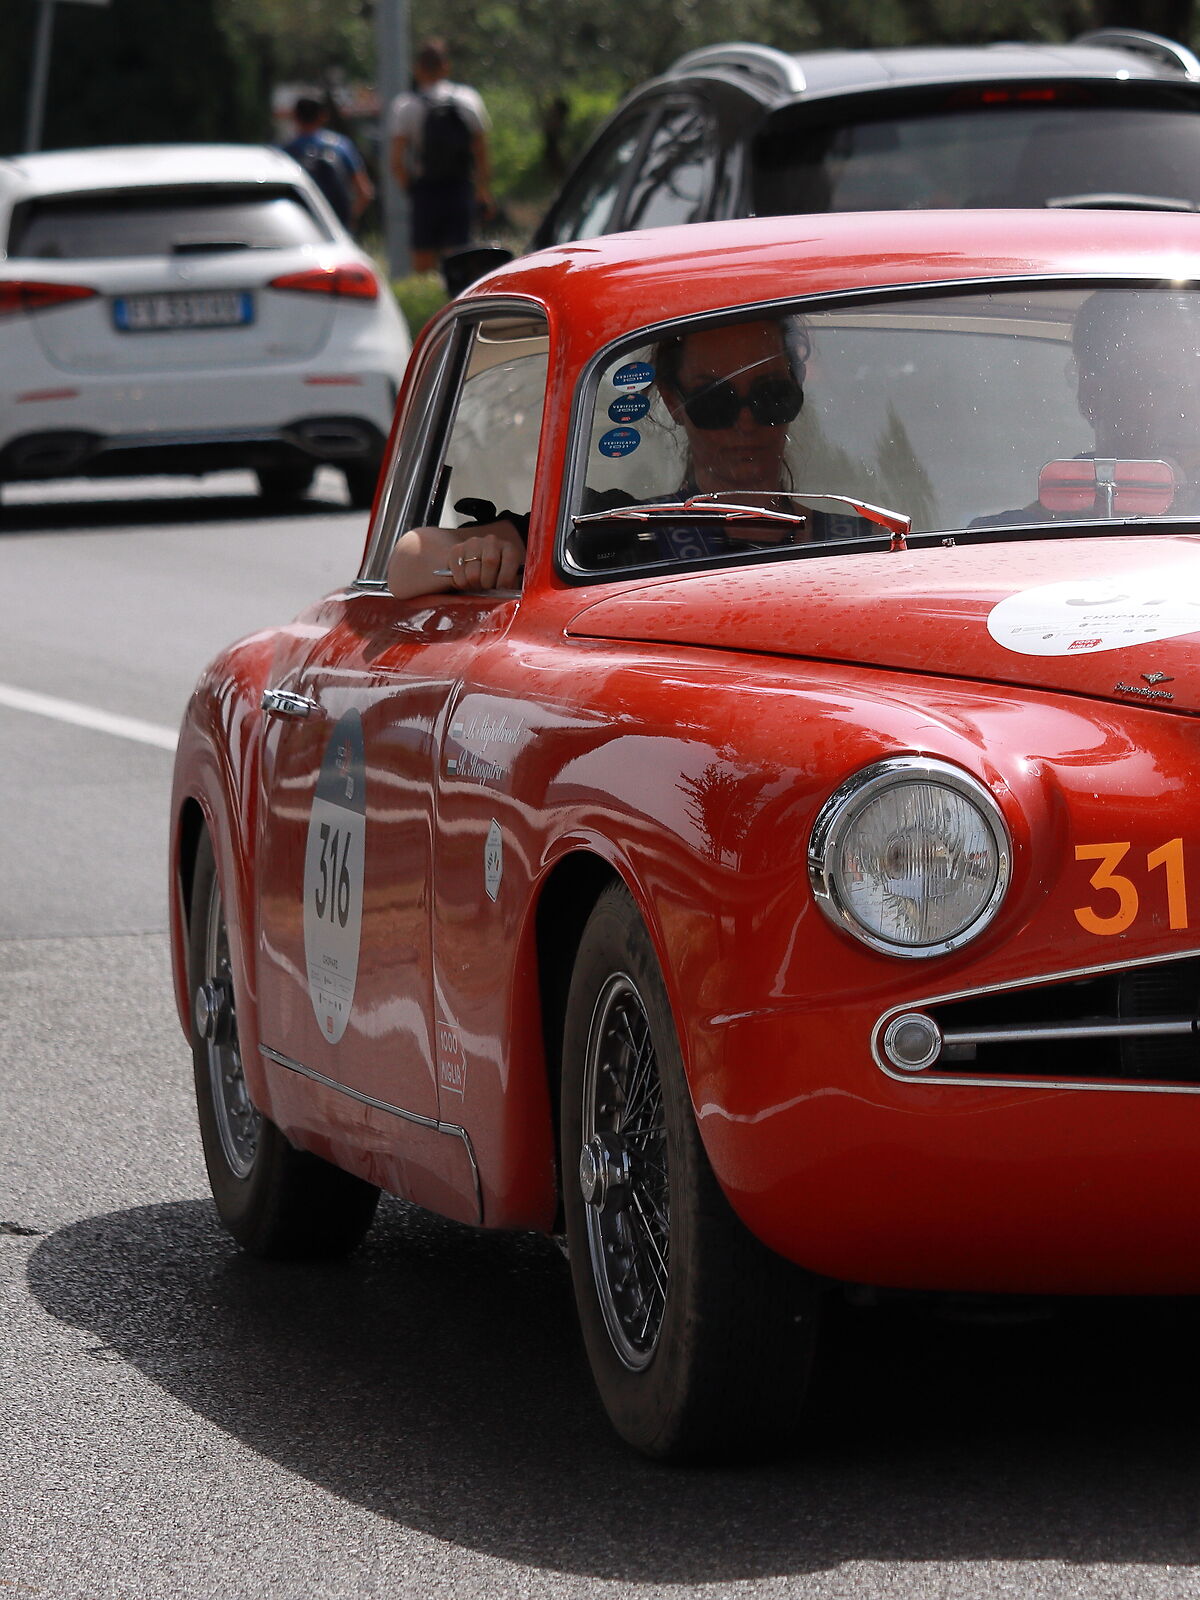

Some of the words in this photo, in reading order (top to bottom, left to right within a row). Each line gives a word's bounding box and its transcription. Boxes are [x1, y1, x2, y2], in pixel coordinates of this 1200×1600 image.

[616, 372, 650, 380] VERIFICATO
[315, 822, 352, 929] 316
[440, 1030, 458, 1054] 1000
[440, 1061, 462, 1086] MIGLIA
